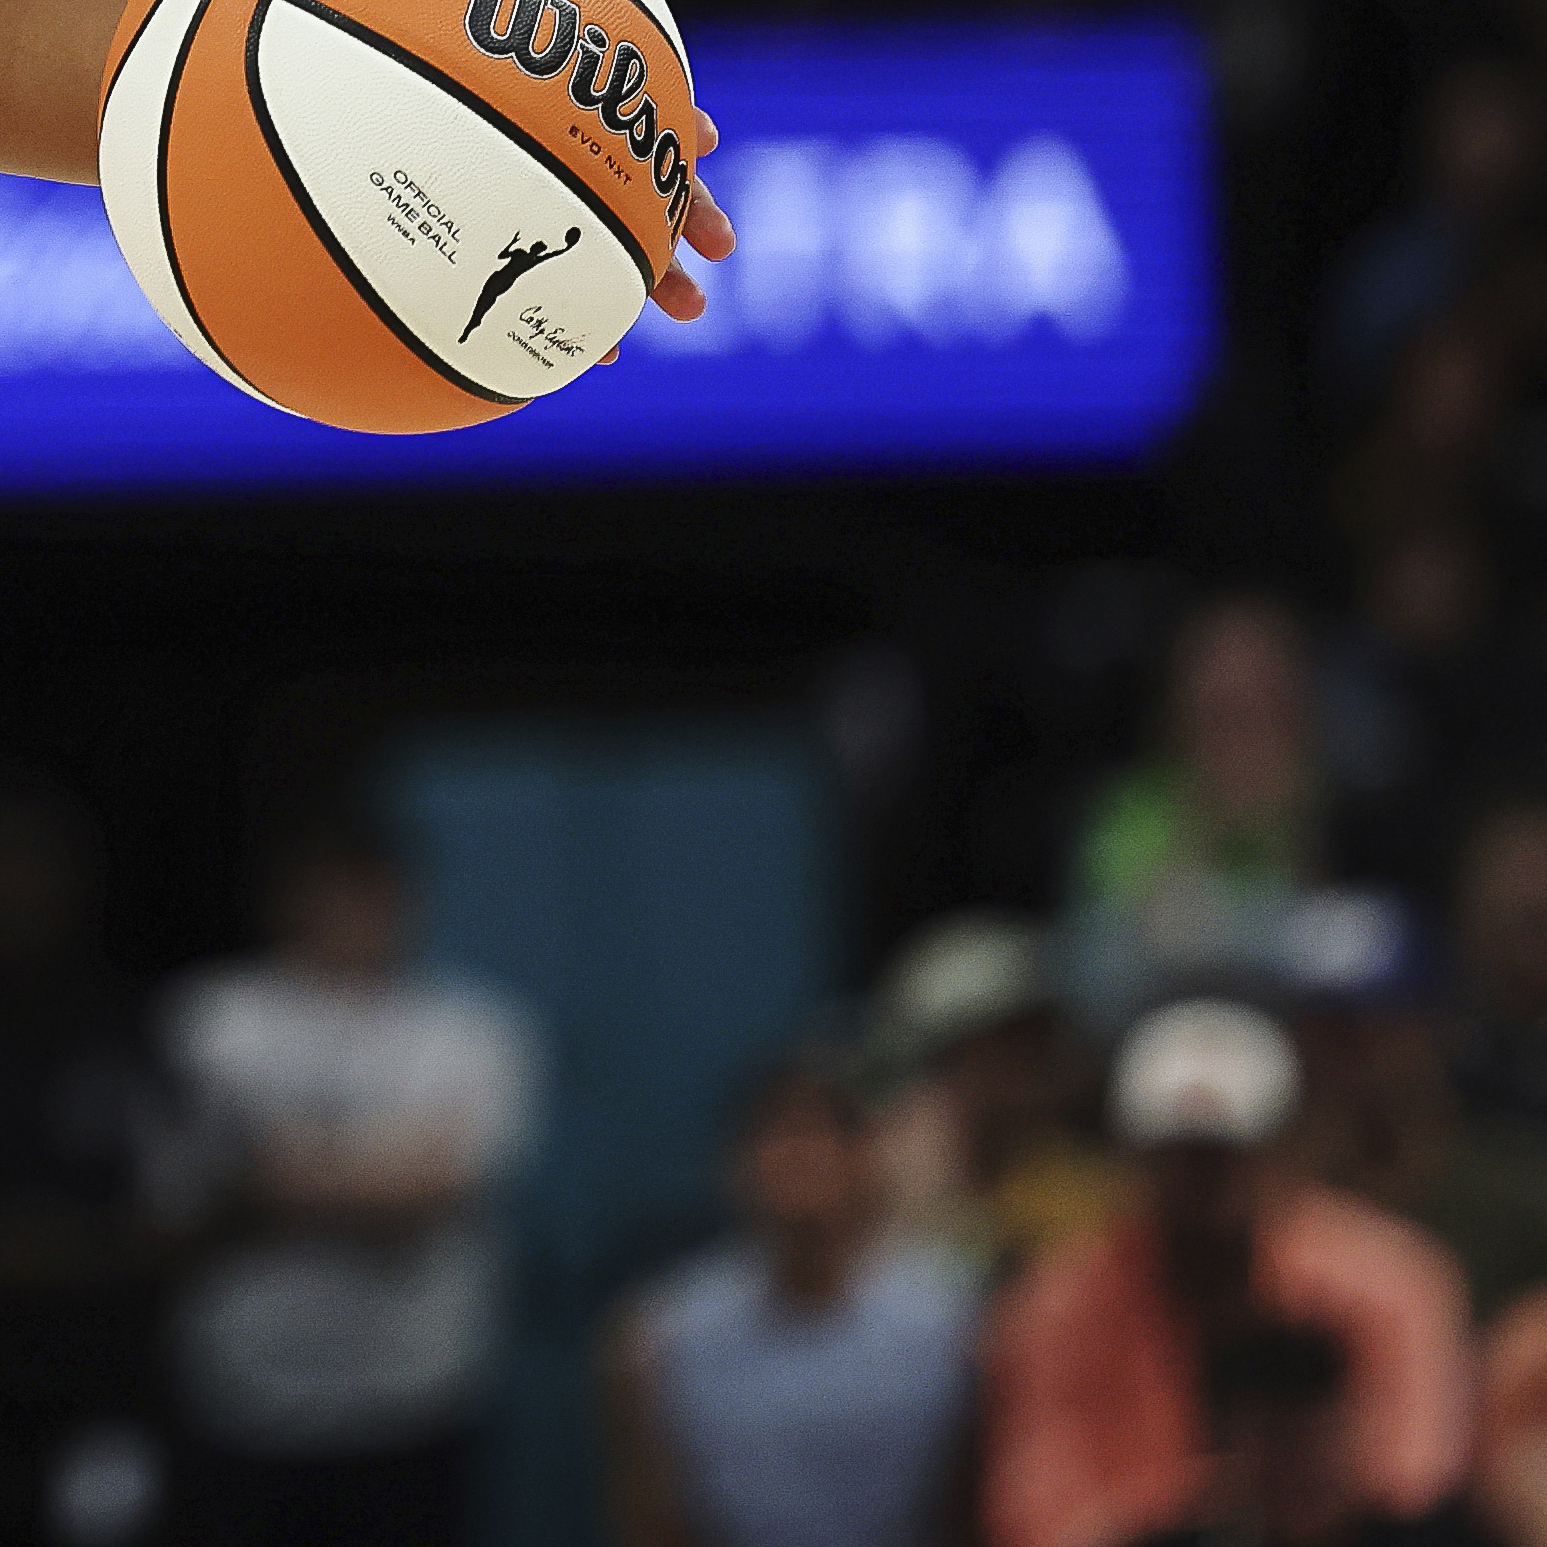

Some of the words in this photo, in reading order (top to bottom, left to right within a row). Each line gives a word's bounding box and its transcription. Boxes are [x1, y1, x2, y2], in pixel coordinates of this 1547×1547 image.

[568, 124, 602, 156] EVO
[604, 154, 633, 186] NXT
[369, 171, 420, 224] GAME
[418, 220, 457, 265] BALL
[386, 213, 416, 246] WNBA
[393, 169, 461, 243] OFFICIAL
[651, 133, 1132, 351] TRA
